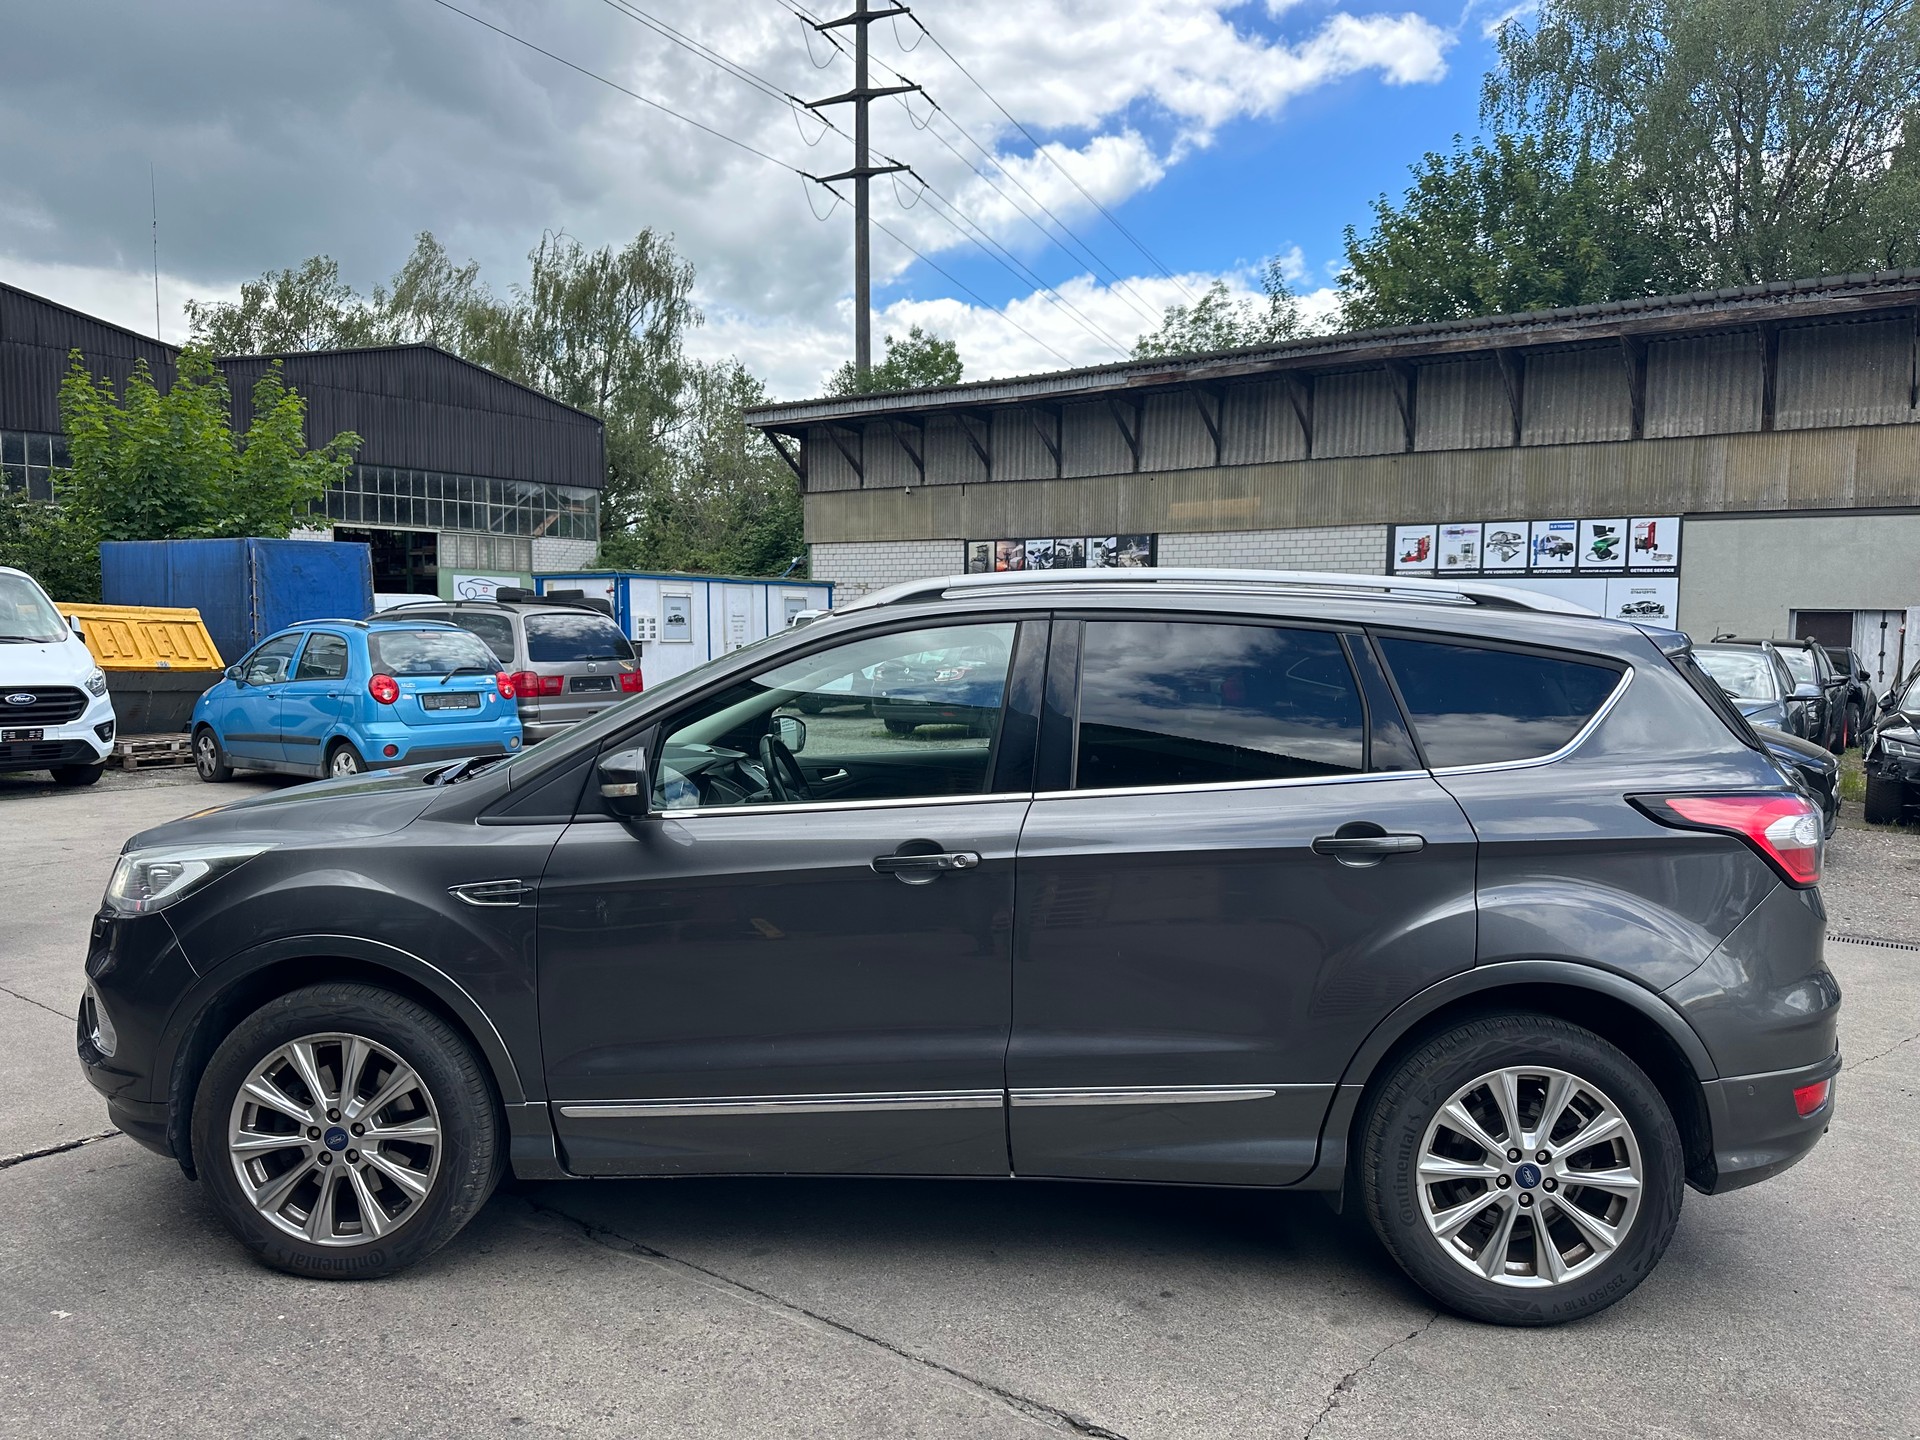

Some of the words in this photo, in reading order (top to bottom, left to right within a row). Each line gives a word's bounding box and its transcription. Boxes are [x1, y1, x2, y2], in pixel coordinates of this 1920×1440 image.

[1569, 1049, 1631, 1090] EcoContact
[1393, 1125, 1417, 1227] Continental
[291, 1249, 387, 1272] Continental
[1588, 1273, 1627, 1300] 235/50
